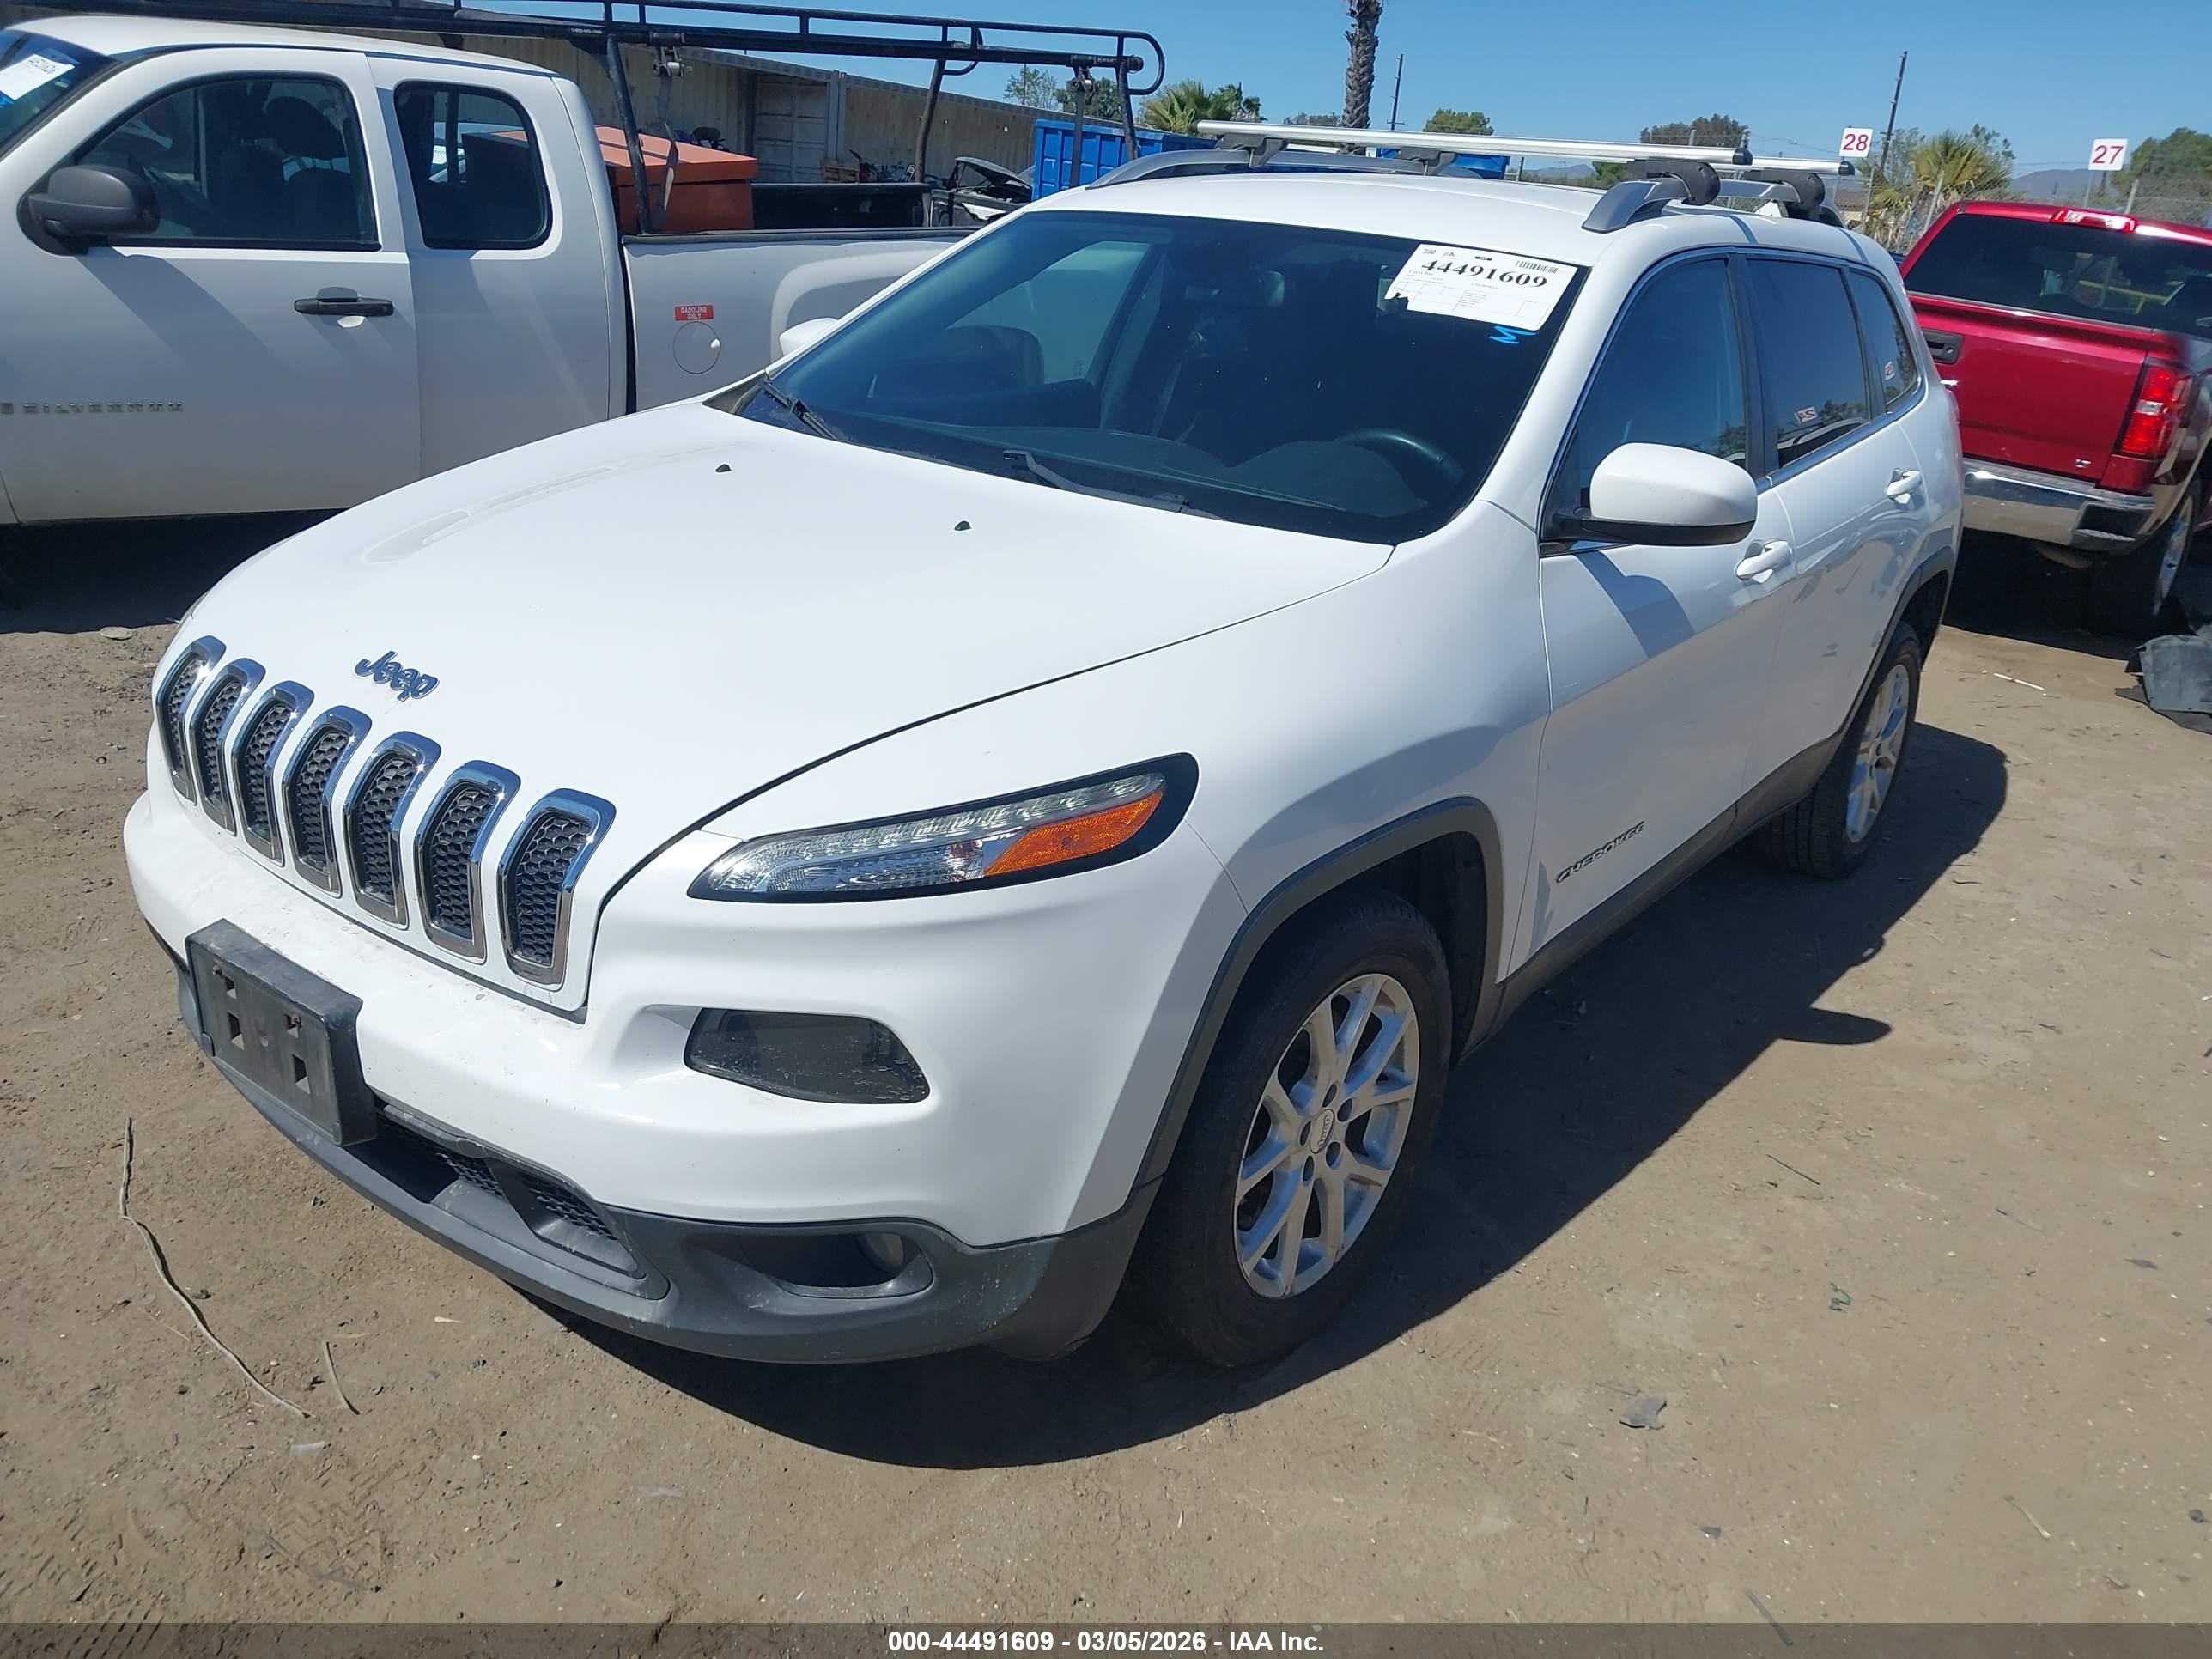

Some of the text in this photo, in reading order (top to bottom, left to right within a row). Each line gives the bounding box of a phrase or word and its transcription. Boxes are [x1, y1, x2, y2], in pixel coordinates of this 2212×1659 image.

[1842, 133, 1869, 152] 28
[2092, 145, 2124, 164] 27
[1421, 259, 1549, 288] 44491609
[680, 306, 708, 314] GASOLINE
[355, 650, 440, 702] Jeep
